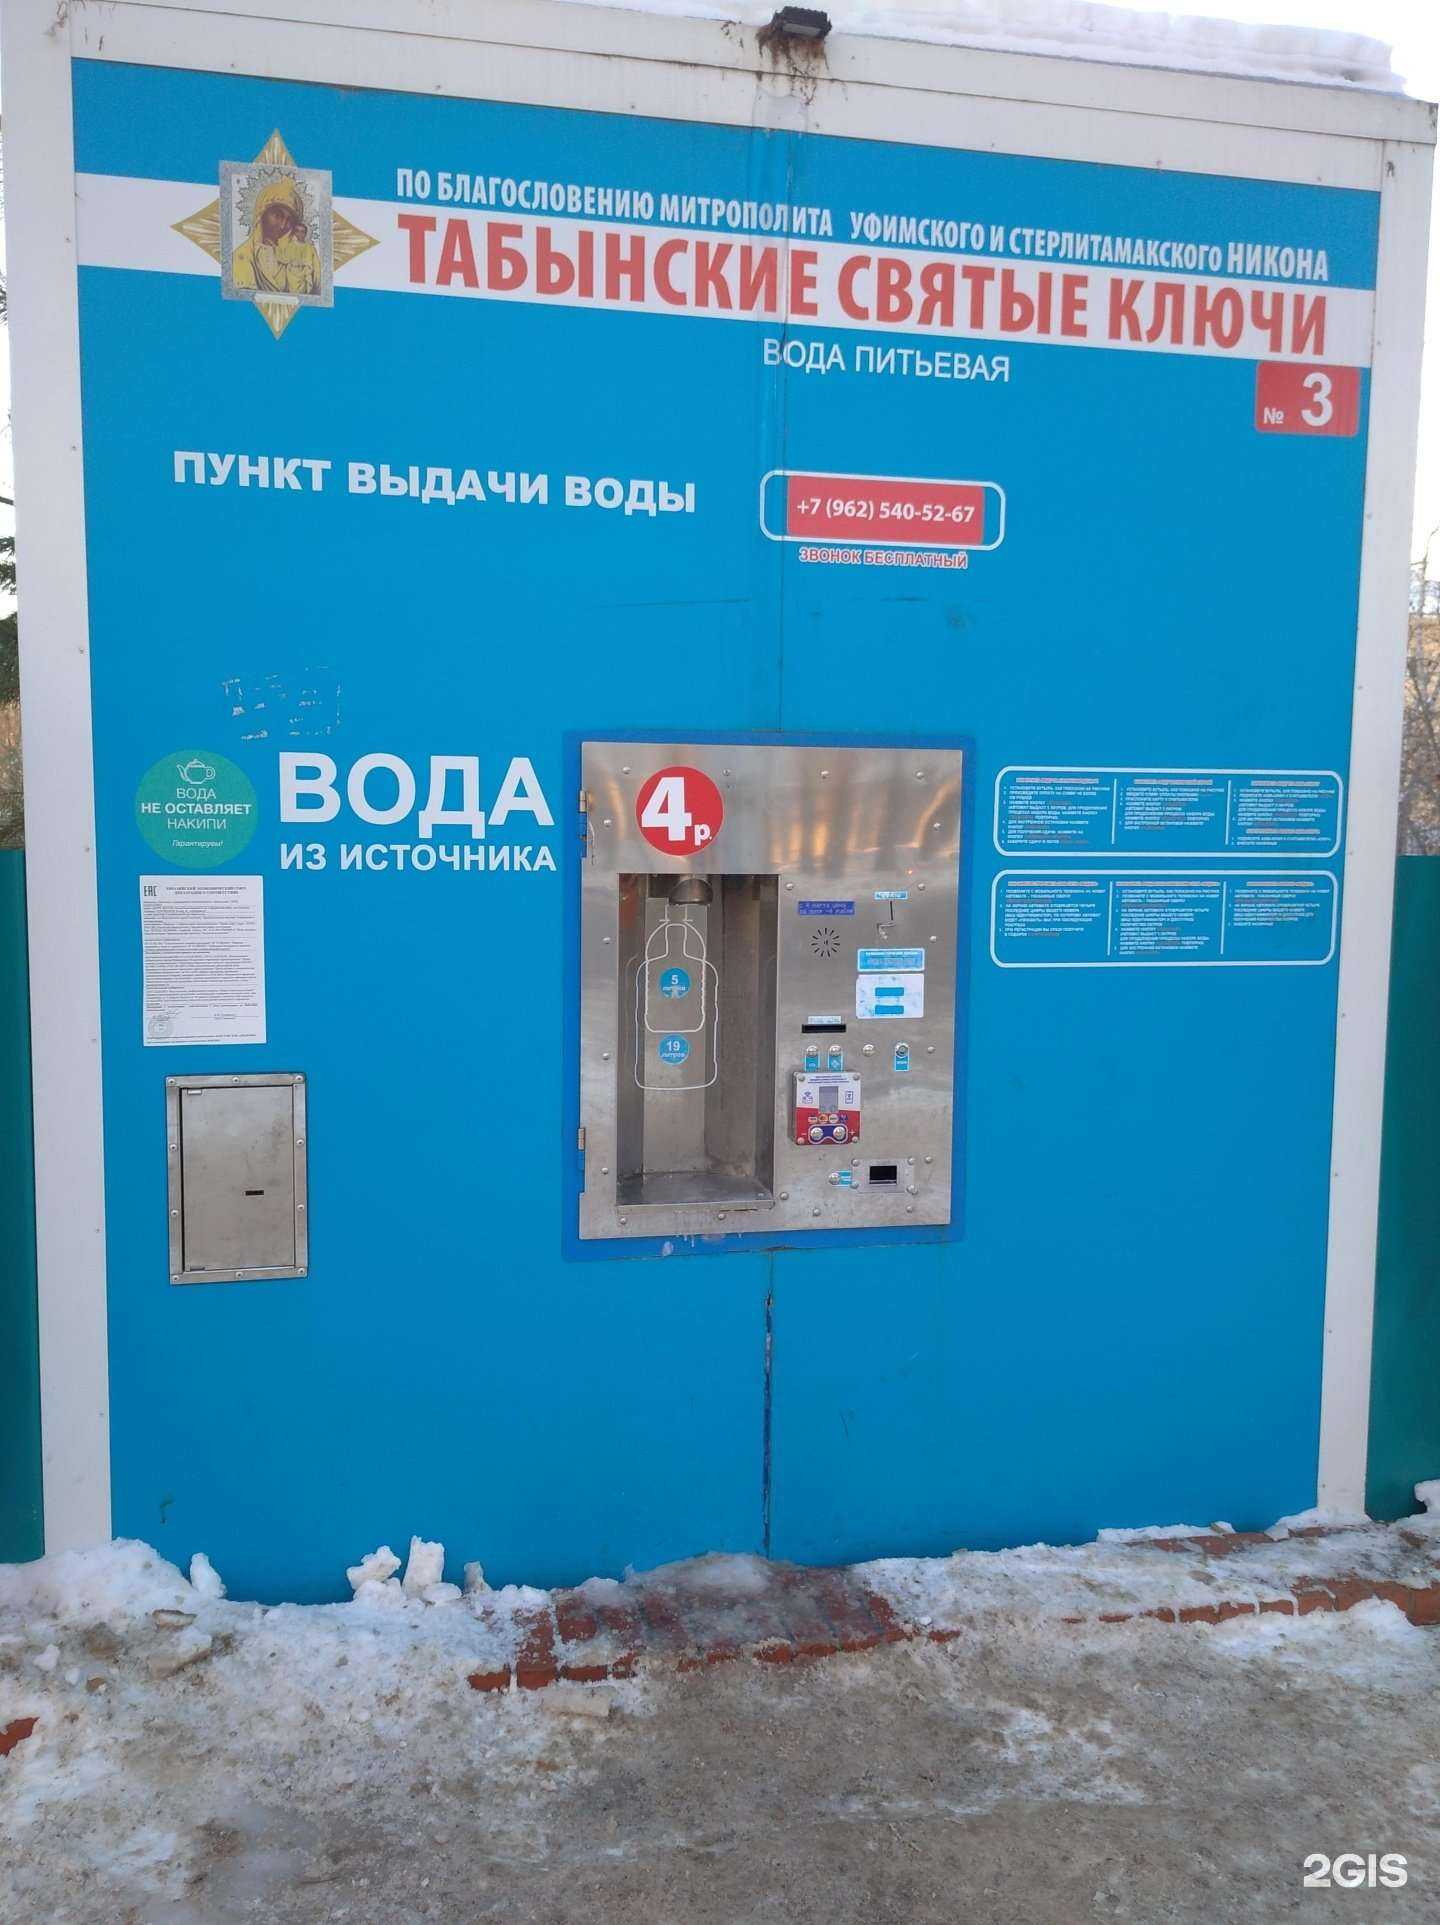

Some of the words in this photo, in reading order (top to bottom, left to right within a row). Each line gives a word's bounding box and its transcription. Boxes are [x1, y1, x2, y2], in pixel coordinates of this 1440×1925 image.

[397, 168, 431, 199] ПО
[437, 172, 654, 221] БЛАГОСЛОВЕНИЮ
[660, 194, 833, 237] МИТРОПОЛИТА
[849, 212, 984, 252] УФИМСКОГО
[990, 225, 1005, 252] И
[1009, 227, 1222, 272] СТЕРЛИТАМАКСКОГО
[1227, 242, 1329, 281] НИКОНА
[398, 213, 818, 317] ТАБЫНСКИЕ
[837, 255, 1088, 339] СВЯТЫЕ
[1108, 277, 1328, 356] КЛЮЧИ
[763, 338, 846, 375] ВОДА
[855, 346, 1010, 382] ПИТЬЕВАЯ
[1263, 406, 1285, 425] №
[1301, 372, 1333, 427] 3
[173, 450, 331, 491] ПУНКТ
[347, 462, 548, 505] ВЫДАЧИ
[564, 475, 695, 516] ВОДЫ
[797, 499, 822, 515] +7
[826, 498, 874, 520] (962)
[879, 501, 975, 523] 540-52-67
[800, 548, 861, 563] ЗВОНОК
[865, 549, 968, 568] БЕСПЛАТНЫЙ
[176, 788, 216, 801] ВОДА
[279, 751, 555, 839] ВОДА
[141, 803, 161, 814] НЕ
[165, 803, 252, 815] ОСТАВЛЯЕТ
[167, 818, 227, 830] НАКИПИ
[280, 843, 327, 870] ИЗ
[340, 844, 557, 872] ИСТОЧНИКА
[671, 974, 679, 985] 5
[667, 1040, 681, 1052] 19
